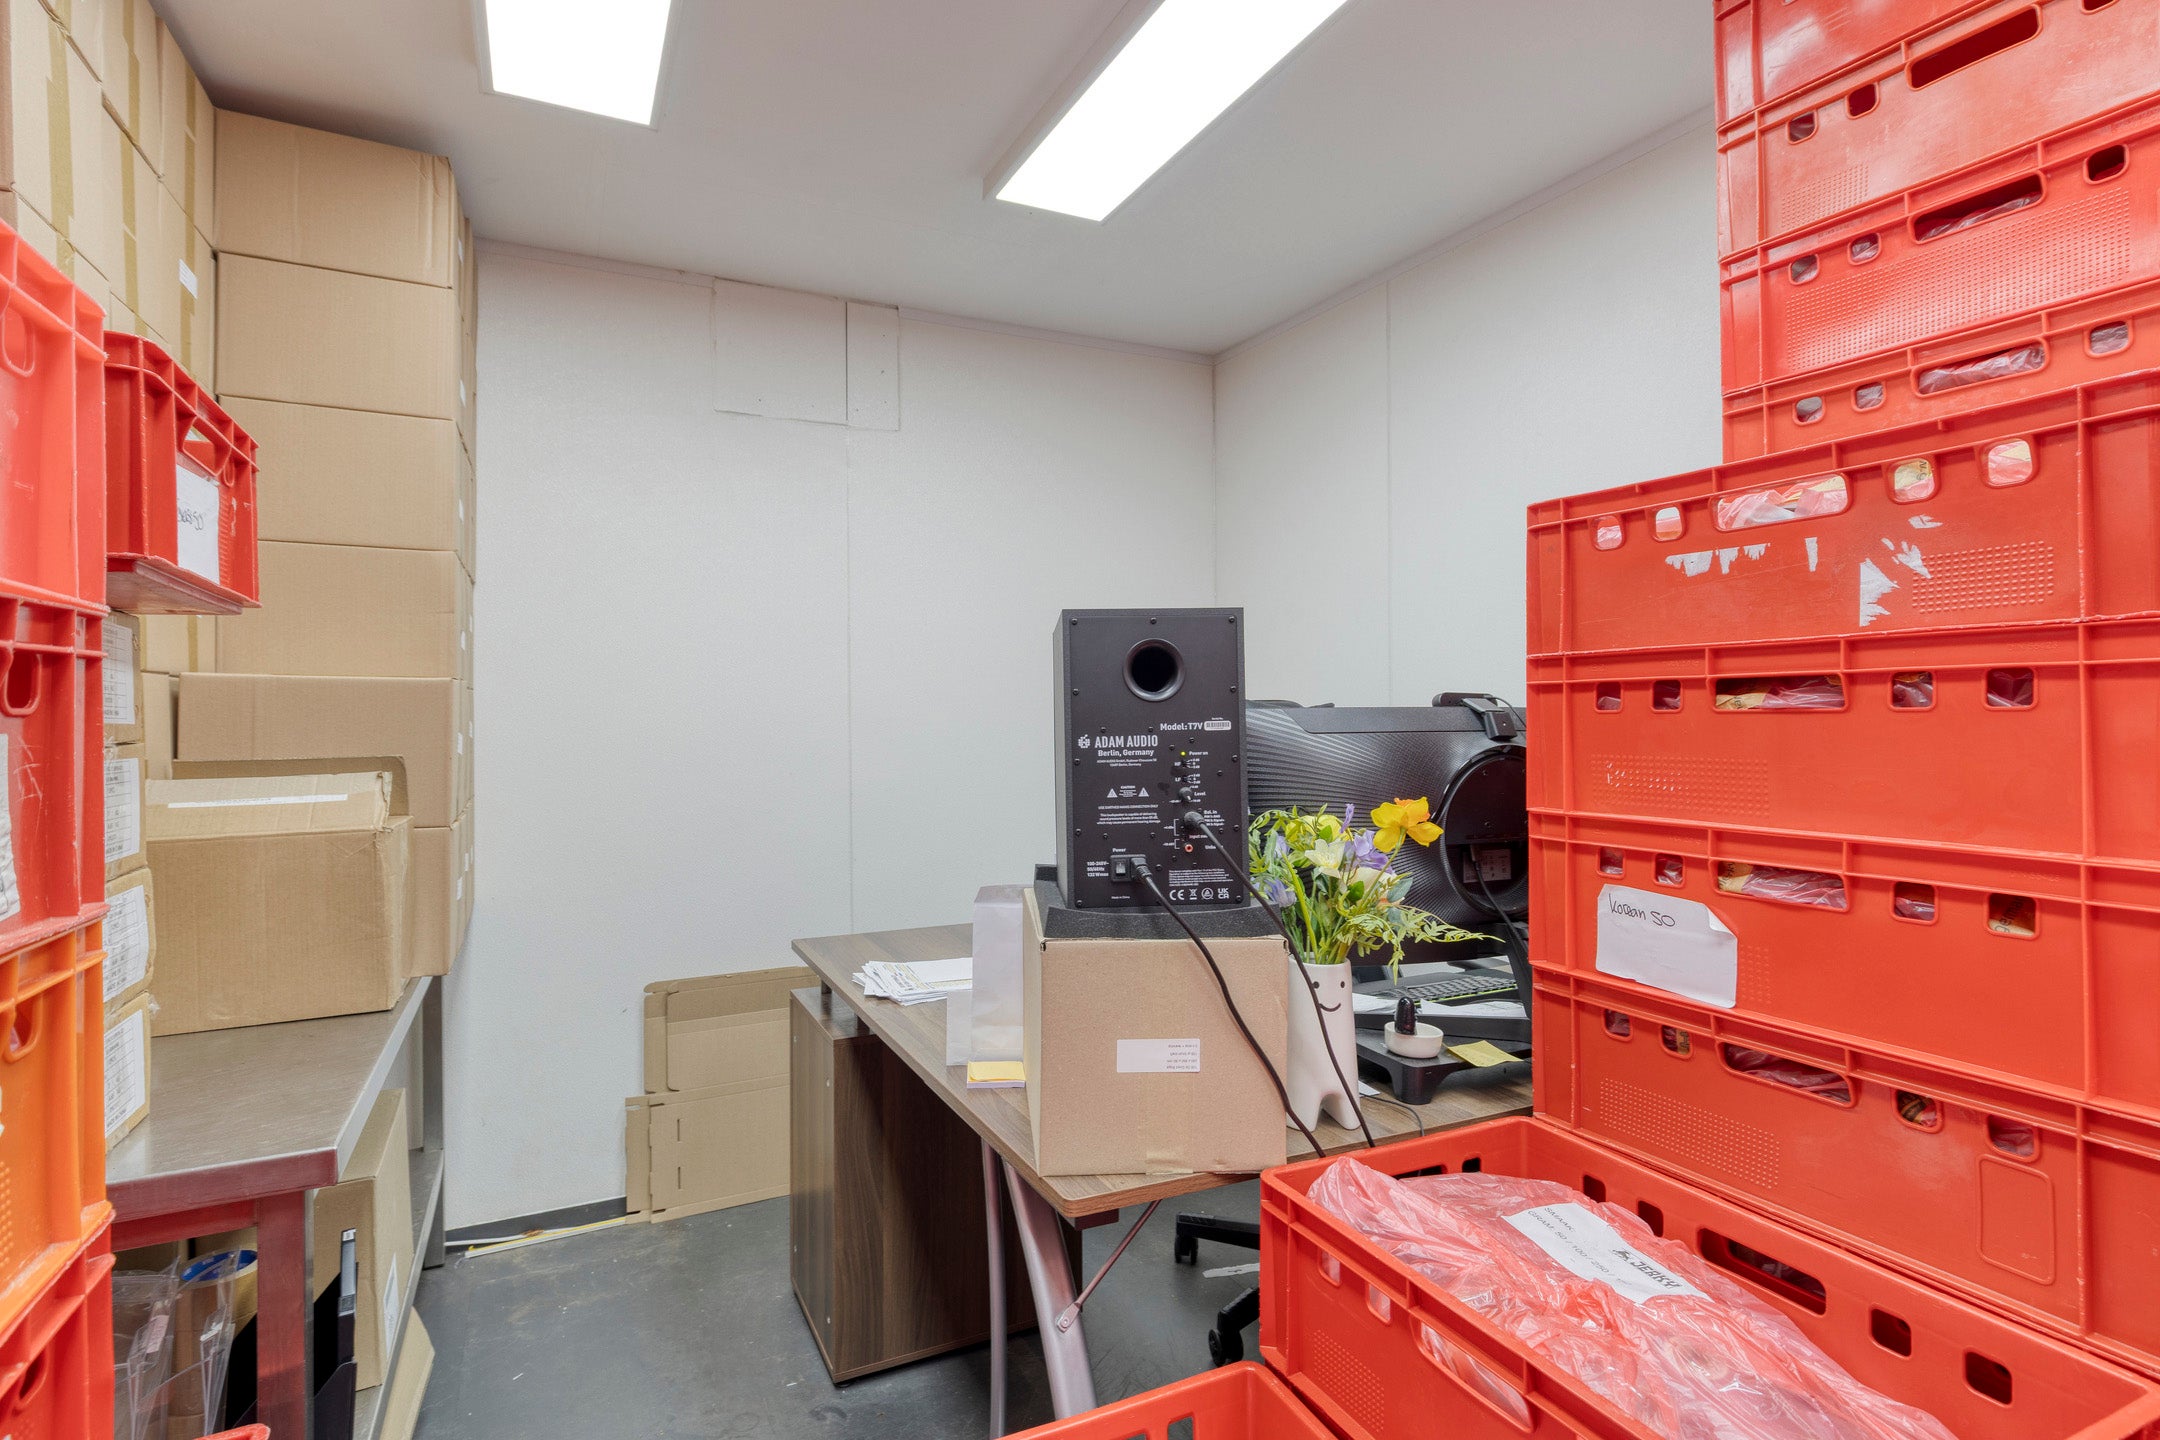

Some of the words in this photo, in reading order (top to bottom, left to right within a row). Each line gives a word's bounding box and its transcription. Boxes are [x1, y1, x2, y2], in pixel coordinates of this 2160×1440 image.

[1094, 736, 1124, 748] ADAM
[1127, 734, 1158, 746] AUDIO
[1630, 1262, 1684, 1290] JERKY
